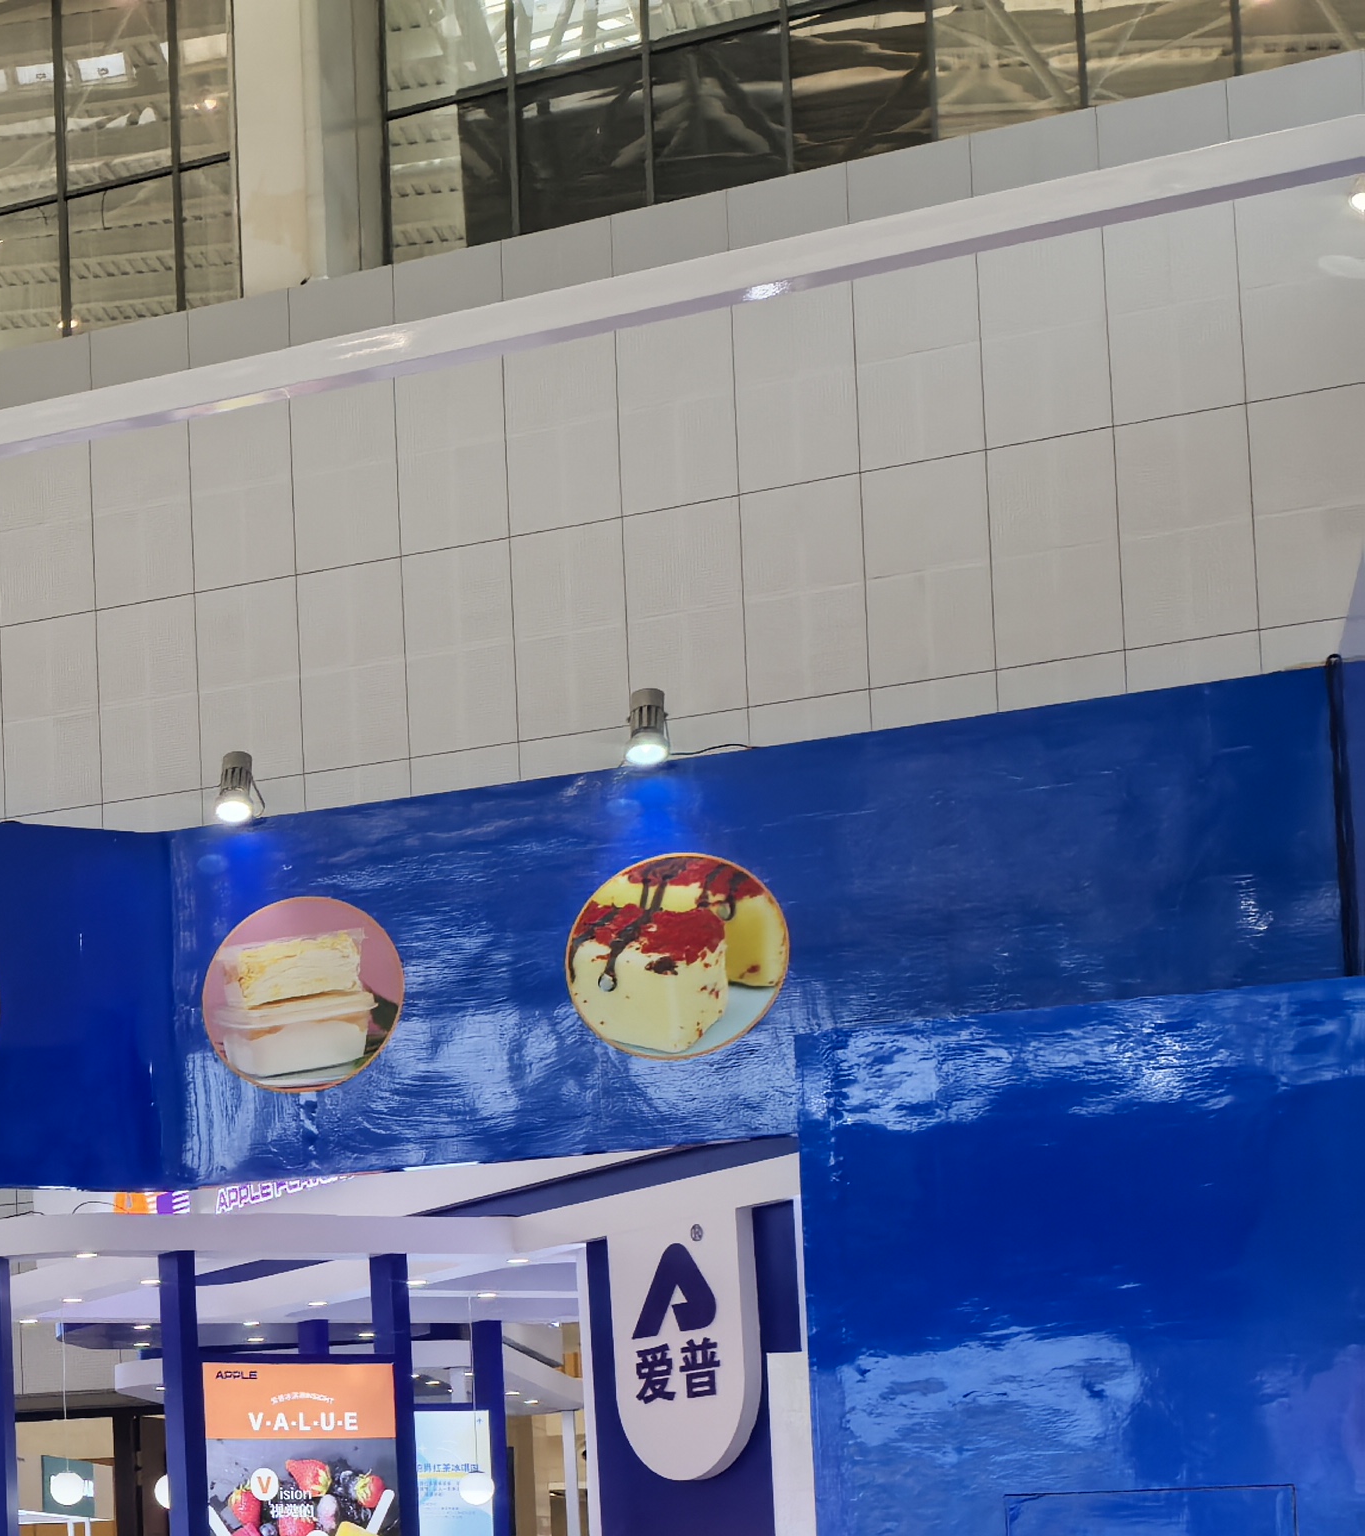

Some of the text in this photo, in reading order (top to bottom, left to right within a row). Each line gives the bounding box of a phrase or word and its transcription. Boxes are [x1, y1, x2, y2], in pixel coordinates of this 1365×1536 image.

[215, 1370, 258, 1380] APPLE
[635, 1337, 721, 1404] 爱普
[270, 1503, 315, 1519] 视觉的
